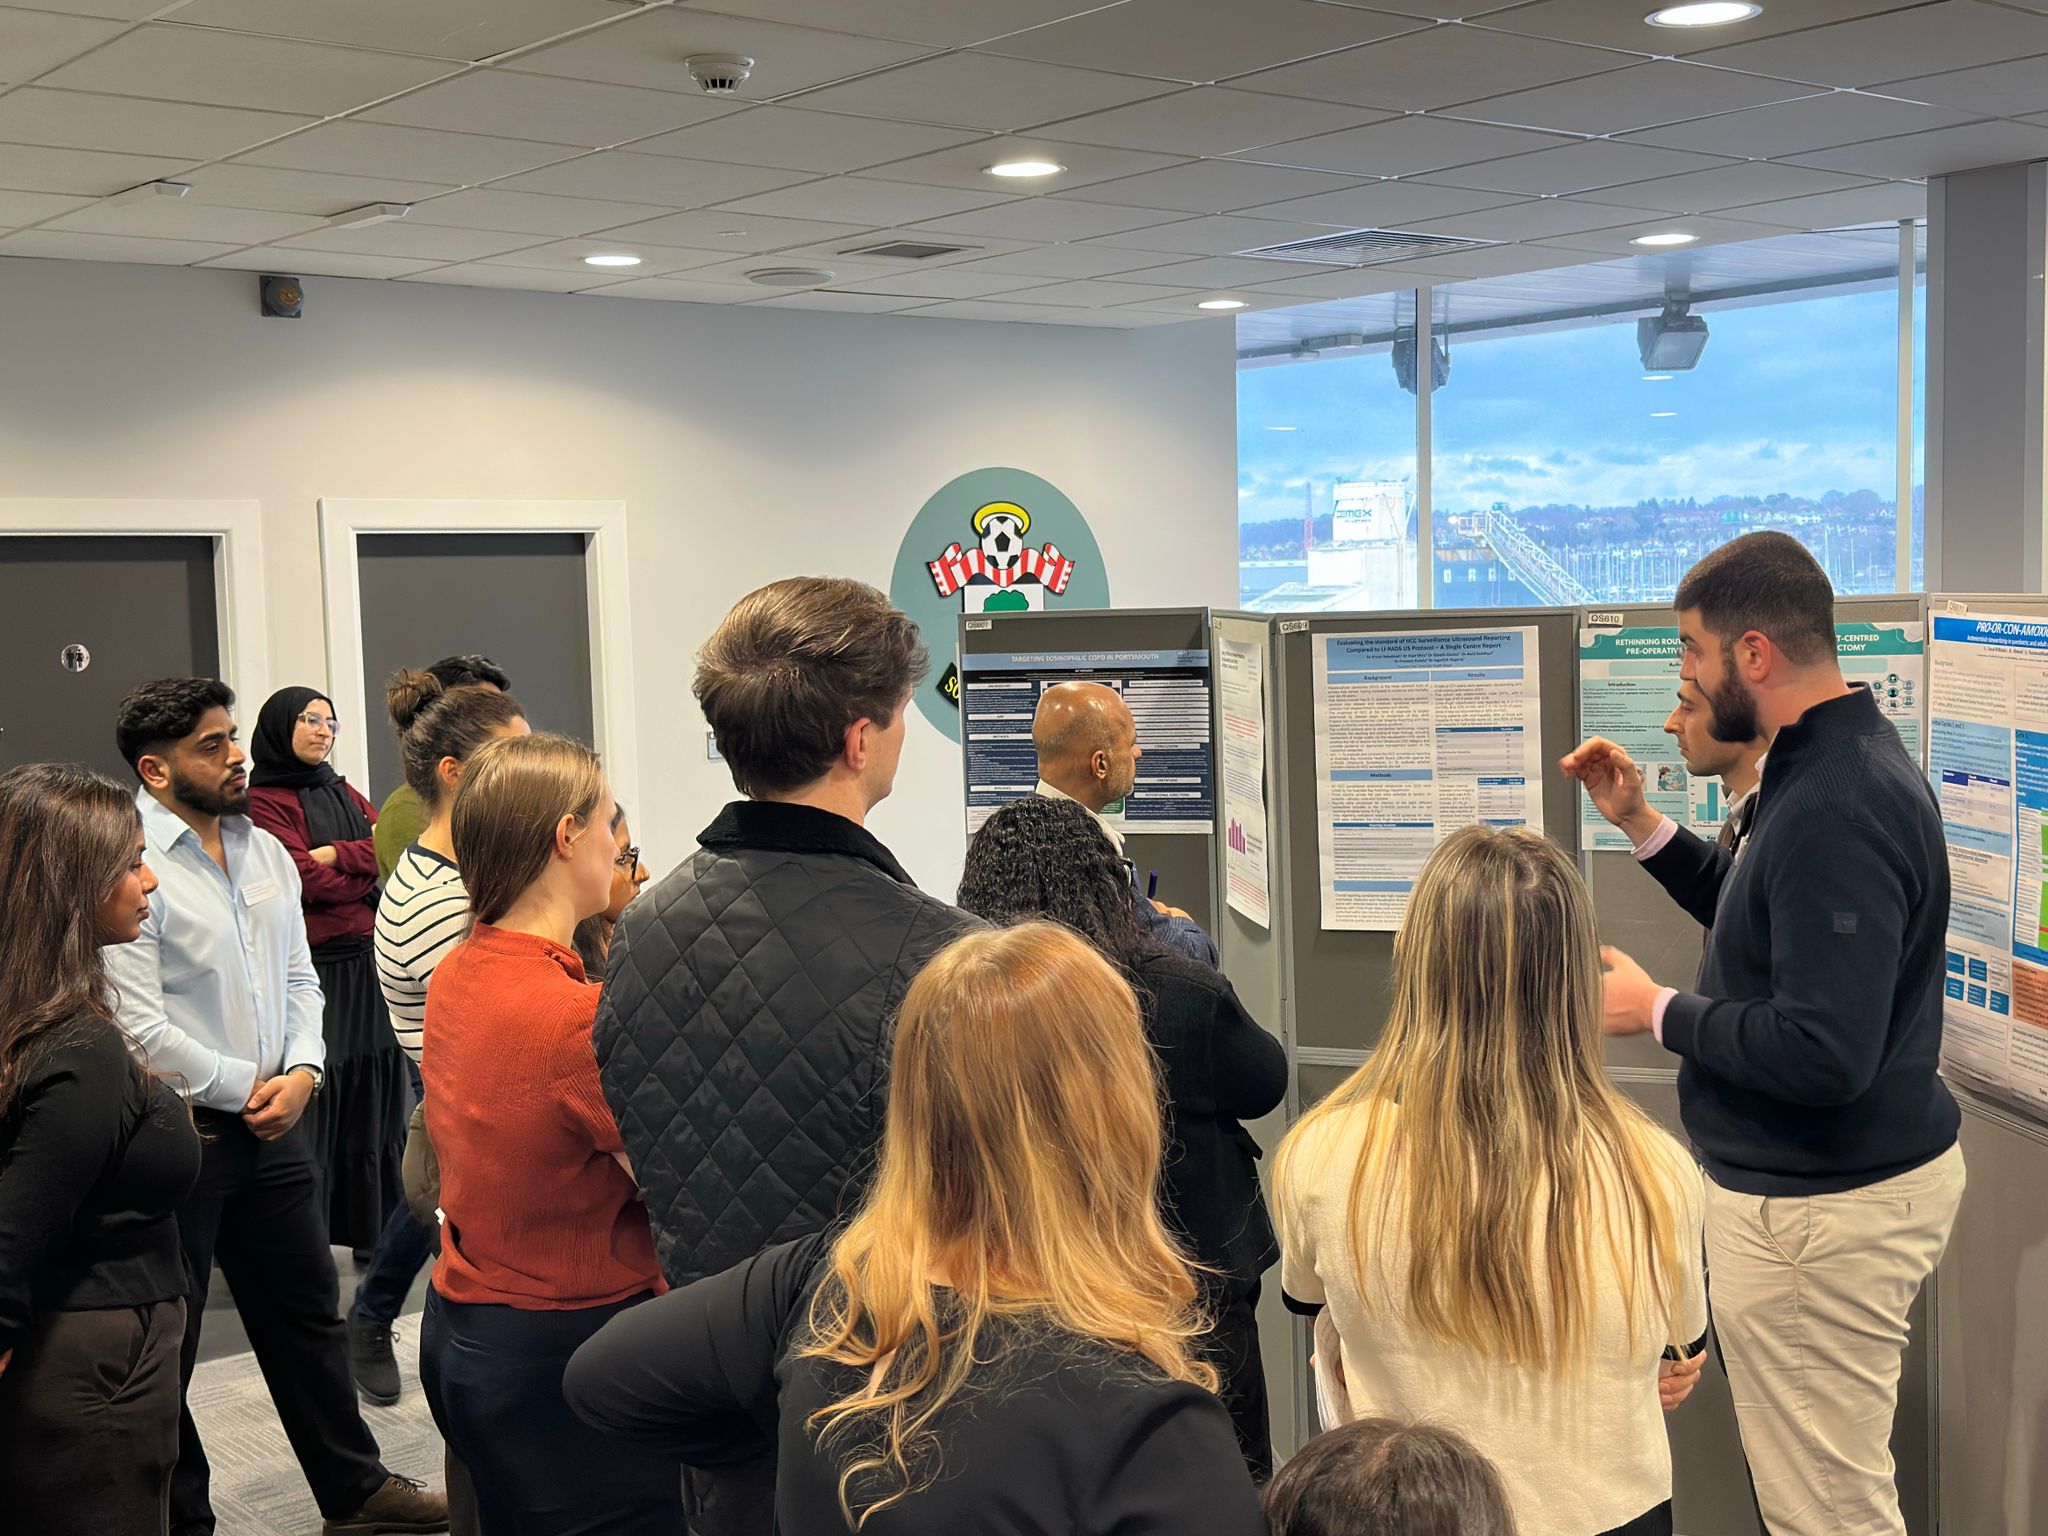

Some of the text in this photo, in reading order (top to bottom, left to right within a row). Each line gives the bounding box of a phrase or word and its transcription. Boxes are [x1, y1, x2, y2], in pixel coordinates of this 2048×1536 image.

[1591, 614, 1620, 623] QS610
[1282, 621, 1308, 631] QS609
[1483, 634, 1511, 642] Reporting
[1615, 638, 1660, 646] RETHINKING
[1836, 634, 1880, 642] T-CENTRED
[1837, 643, 1866, 651] CTOMY
[1114, 653, 1159, 661] PORTSMOUTH
[944, 676, 960, 699] SO
